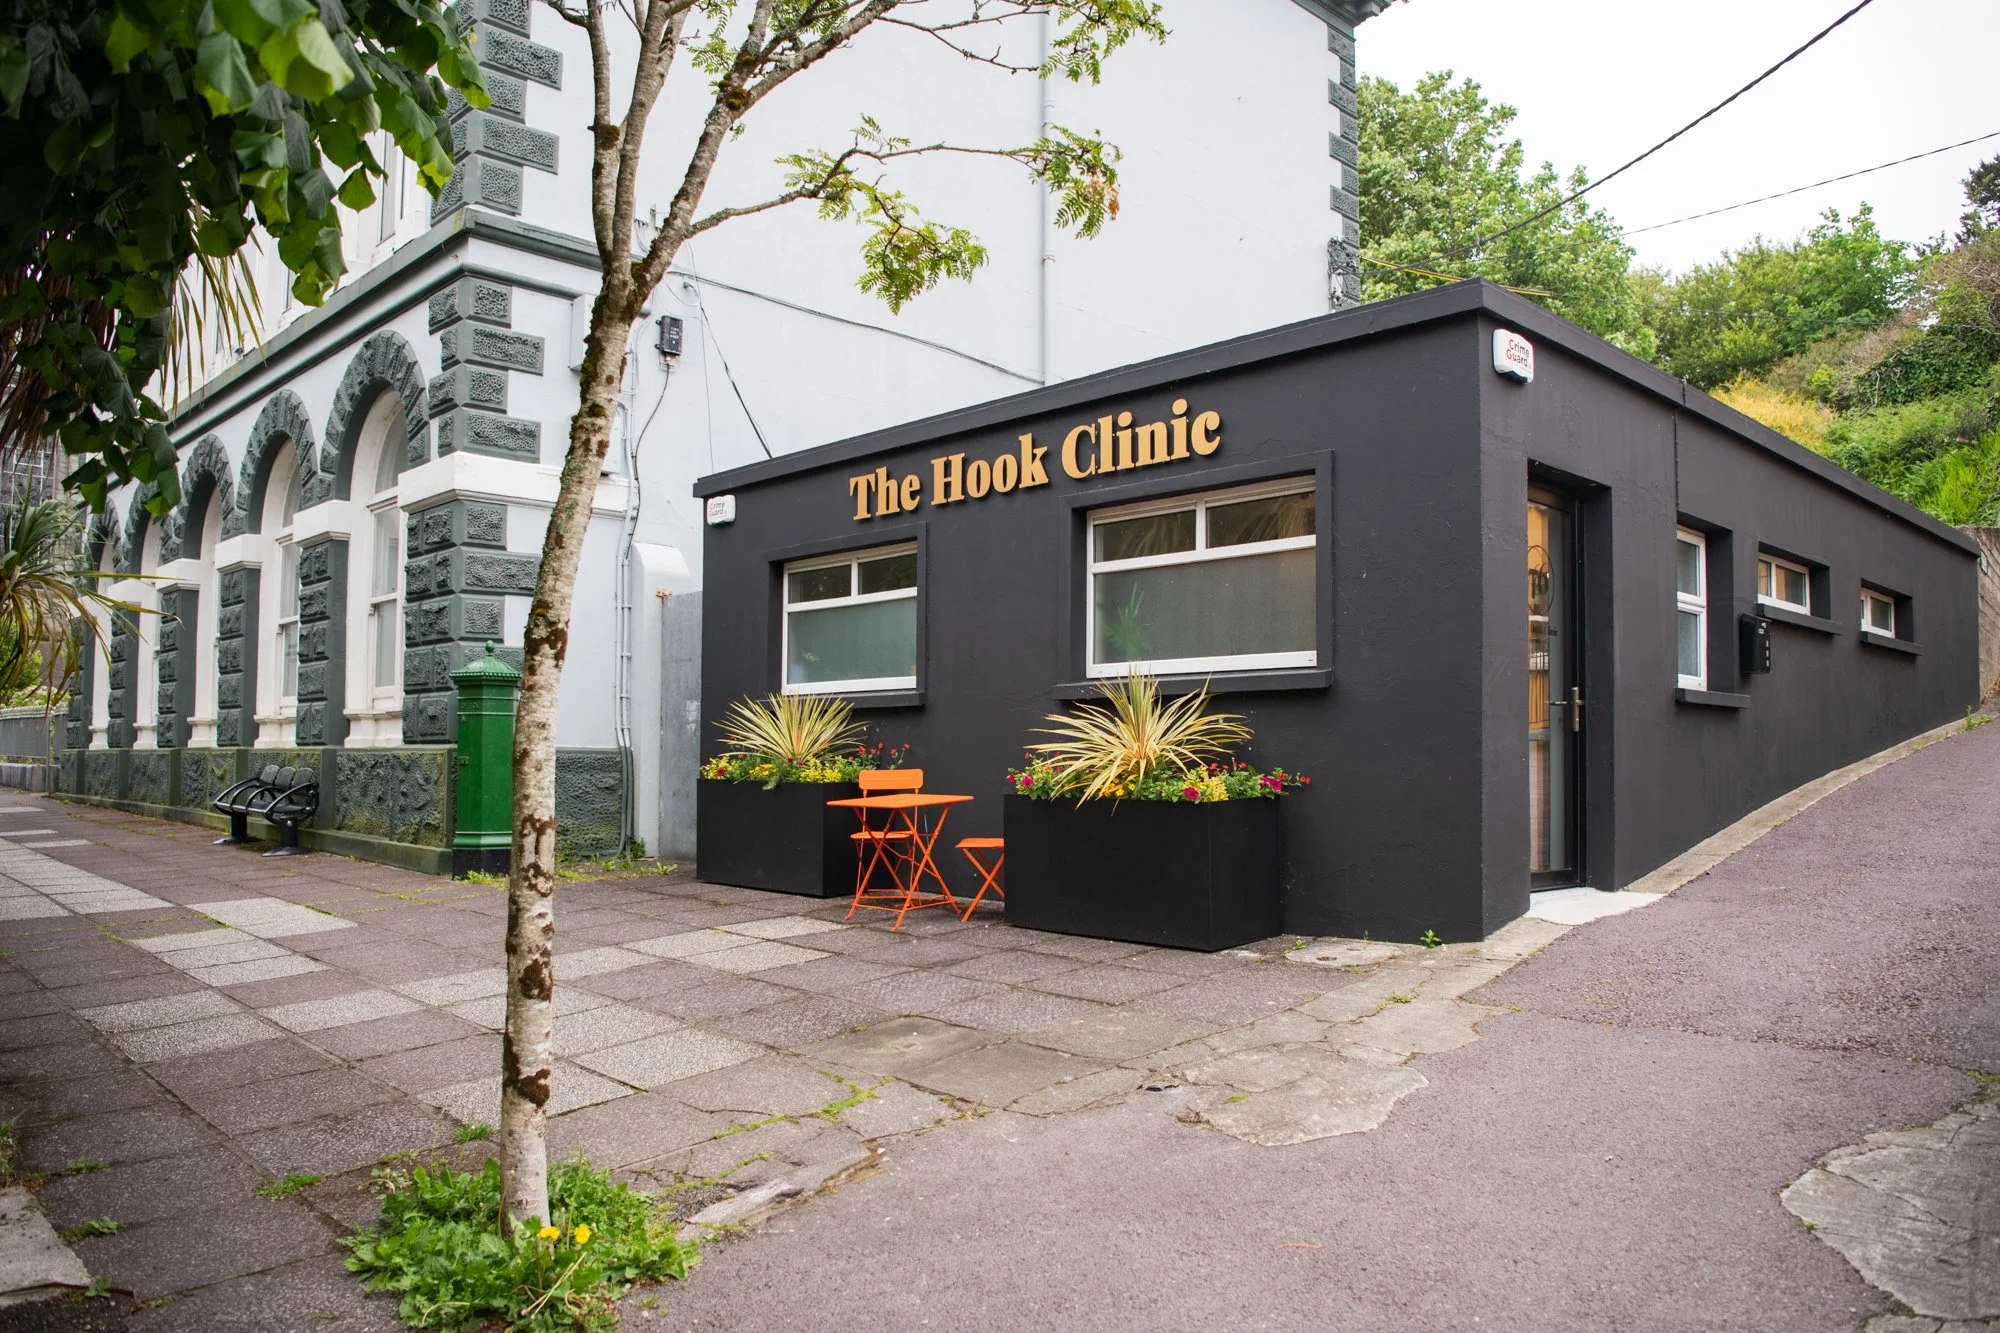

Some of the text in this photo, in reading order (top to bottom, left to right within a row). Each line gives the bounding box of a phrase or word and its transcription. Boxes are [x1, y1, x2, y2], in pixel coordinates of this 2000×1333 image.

[1506, 349, 1528, 366] Guard
[1509, 340, 1530, 358] Crime
[849, 398, 1221, 521] The Hook Clinic
